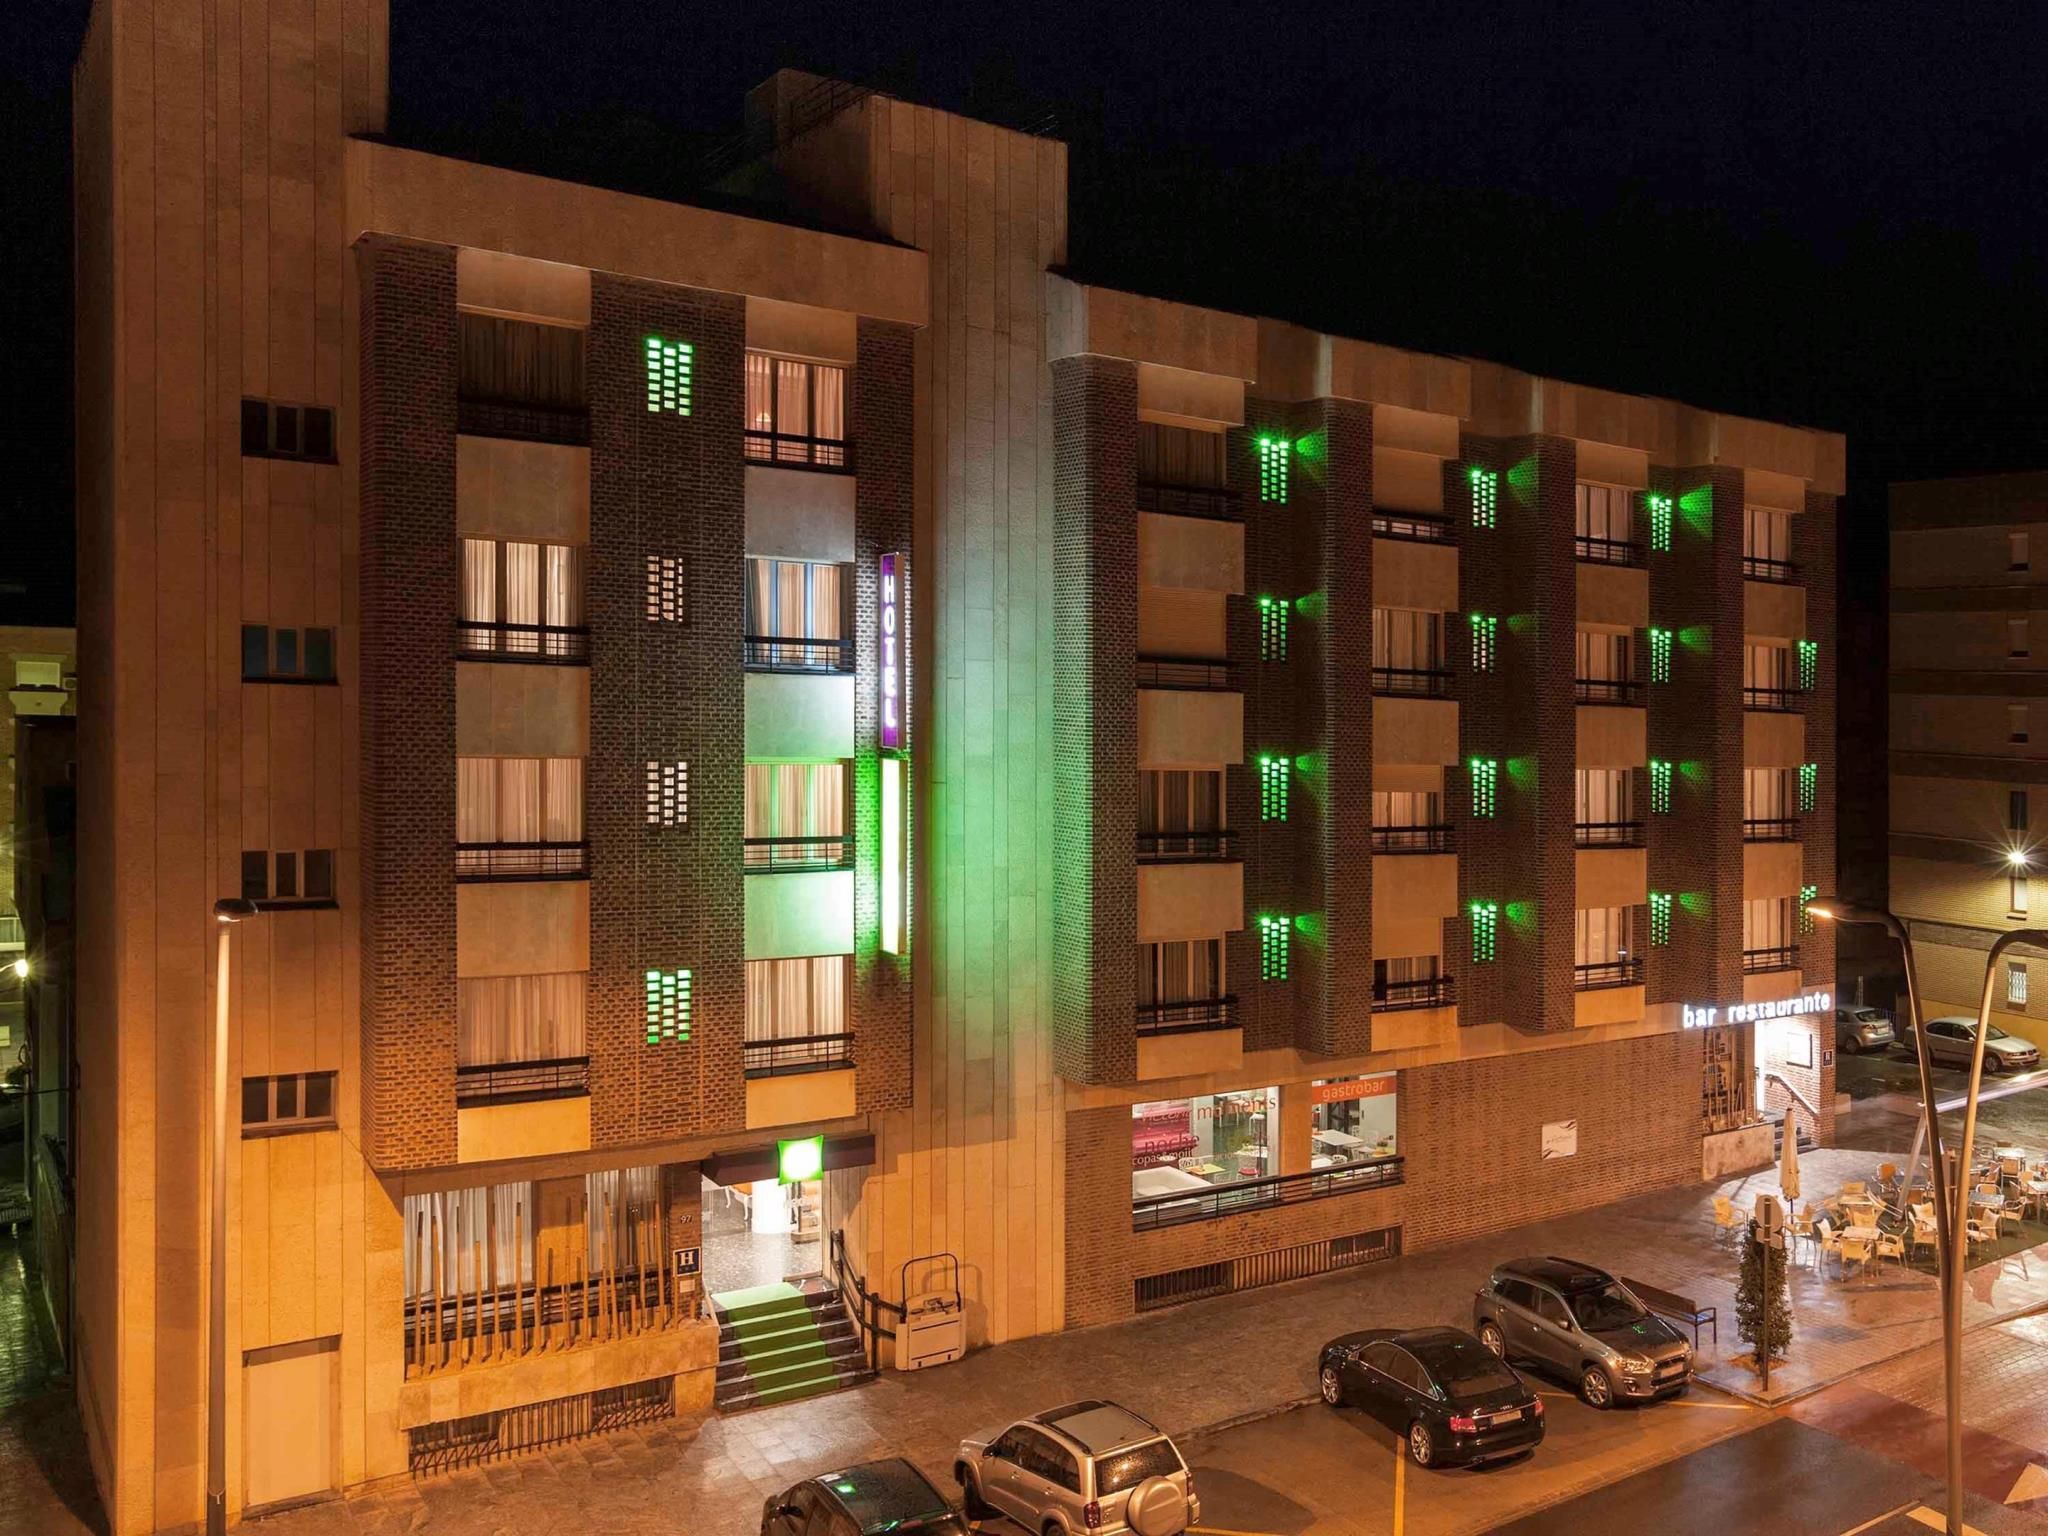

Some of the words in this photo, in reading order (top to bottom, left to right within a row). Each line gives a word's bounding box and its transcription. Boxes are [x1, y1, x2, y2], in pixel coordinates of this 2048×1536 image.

[883, 575, 896, 728] HOTEL
[1683, 1004, 1717, 1028] bar
[1728, 991, 1831, 1023] restaurante
[1322, 1081, 1385, 1102] gastrobar
[680, 1215, 693, 1224] 97
[680, 1251, 695, 1266] H
